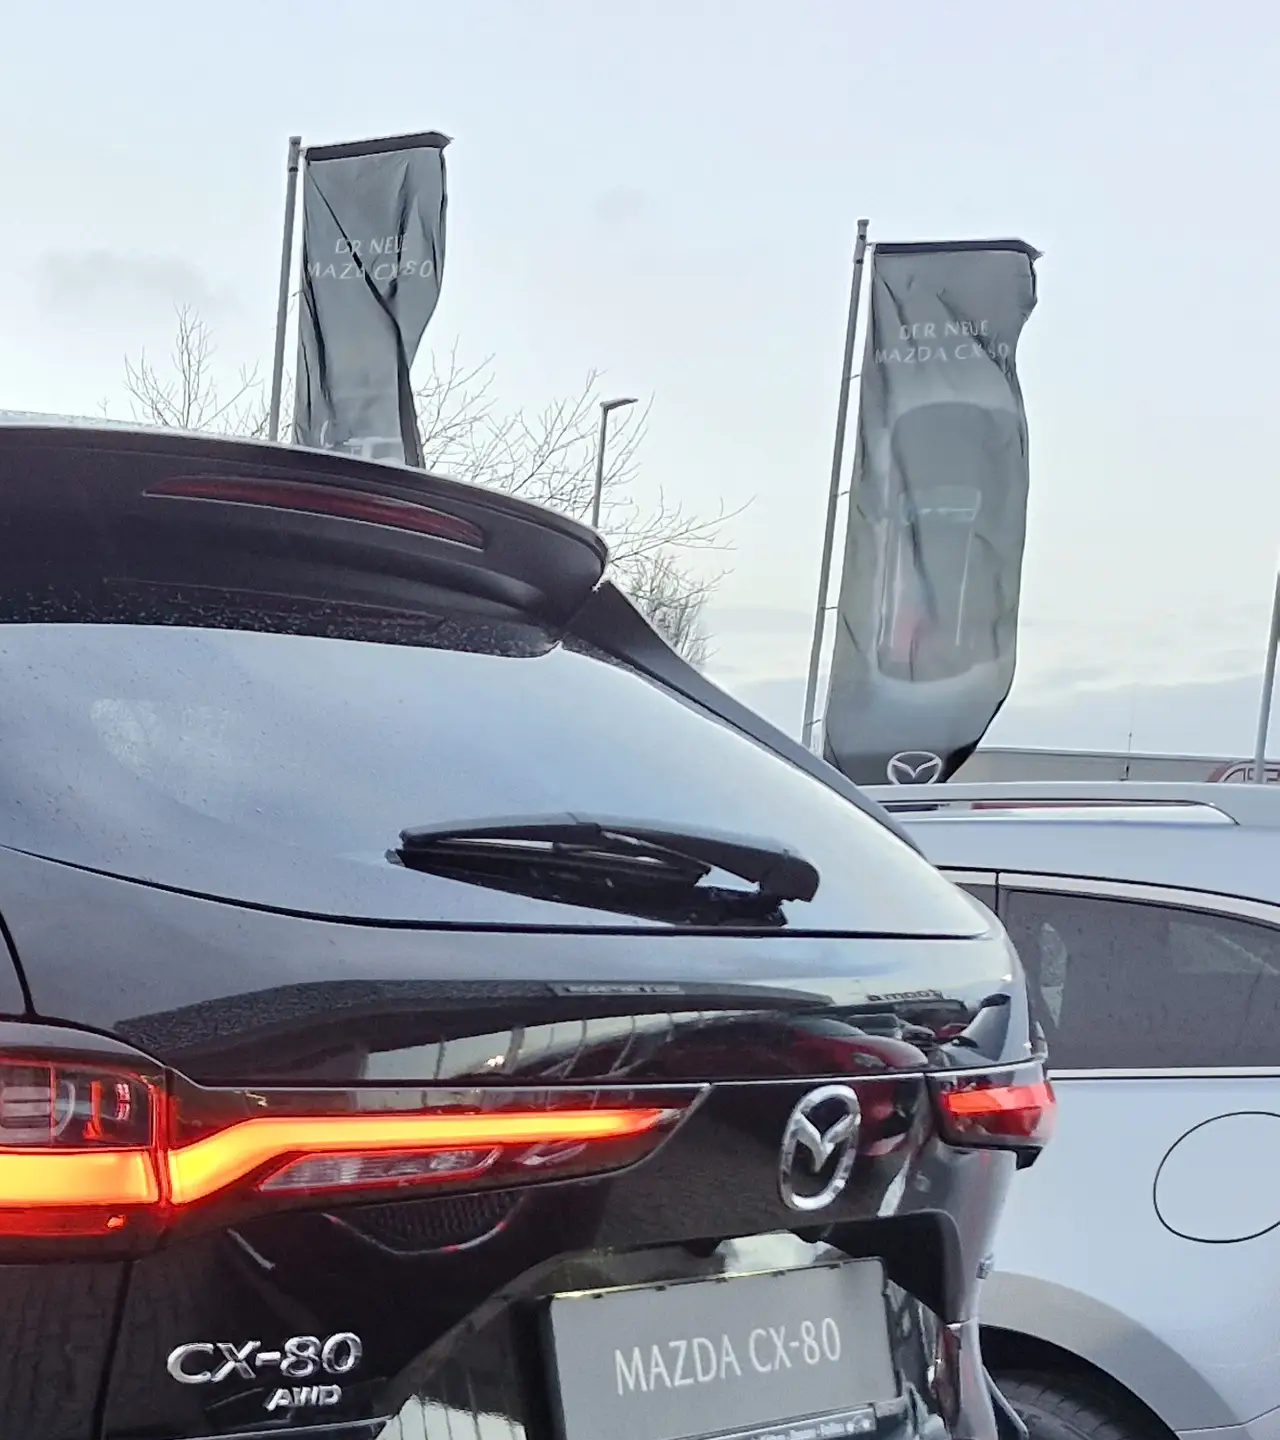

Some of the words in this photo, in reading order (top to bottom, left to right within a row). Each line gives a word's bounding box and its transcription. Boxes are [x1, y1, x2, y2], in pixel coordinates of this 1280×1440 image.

[874, 345, 948, 364] MAZDA
[167, 1332, 363, 1384] CX-80
[614, 1333, 741, 1397] MAZDA
[749, 1317, 842, 1374] CX-80
[263, 1384, 342, 1411] AWD
